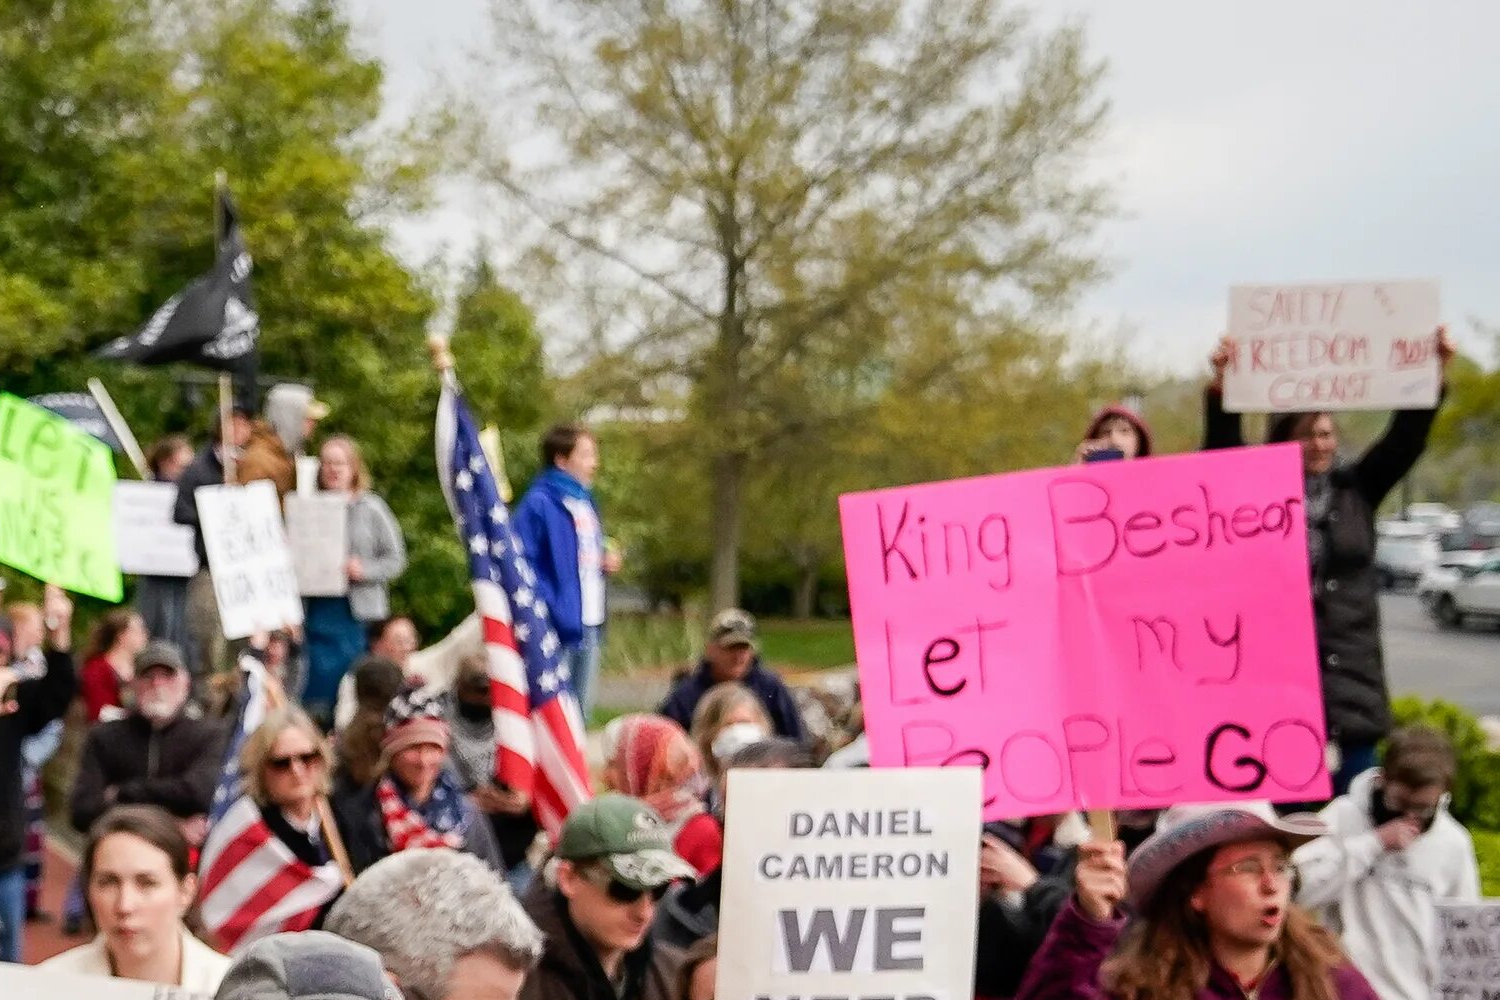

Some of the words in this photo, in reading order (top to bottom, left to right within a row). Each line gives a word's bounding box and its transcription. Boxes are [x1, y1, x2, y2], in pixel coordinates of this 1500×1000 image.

[876, 499, 1013, 591] King
[1047, 474, 1301, 578] Beshear
[1132, 611, 1243, 687] my
[1204, 718, 1324, 795] GO
[789, 808, 933, 839] DANIEL
[757, 851, 950, 881] CAMERON
[778, 906, 926, 973] WE
